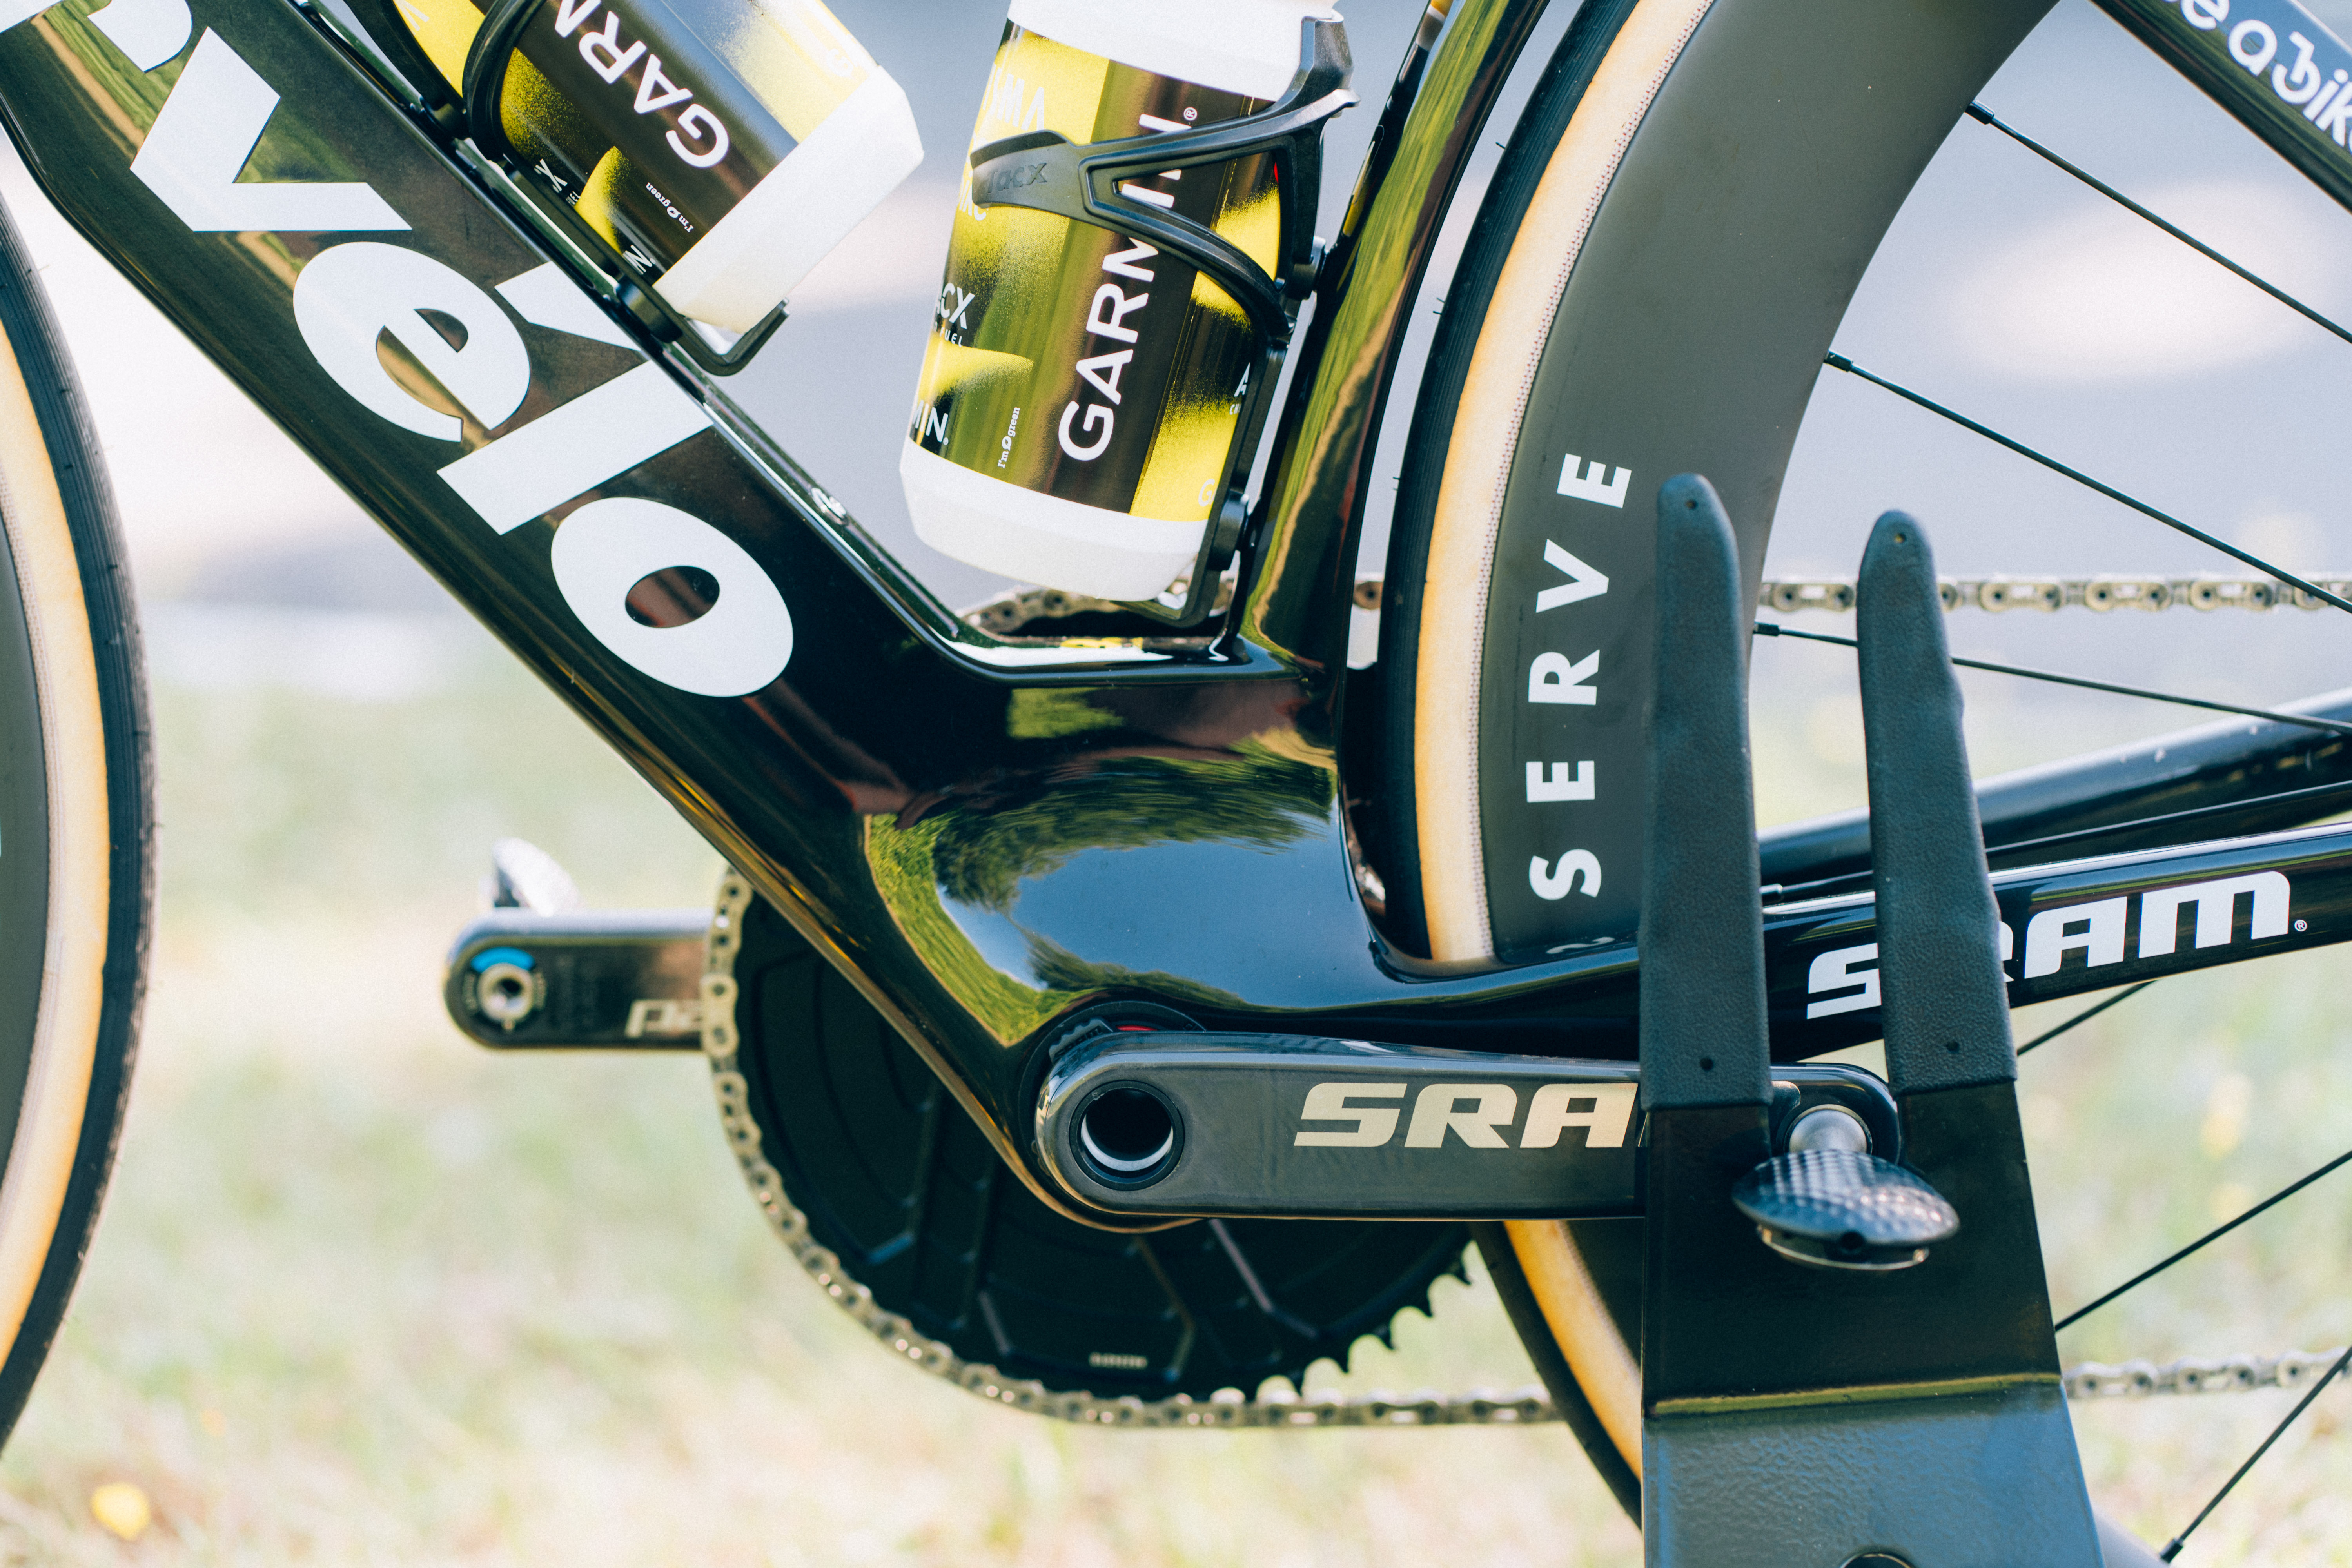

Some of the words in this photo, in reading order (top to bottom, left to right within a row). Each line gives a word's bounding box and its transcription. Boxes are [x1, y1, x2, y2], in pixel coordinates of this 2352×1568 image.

[2272, 31, 2352, 155] bik
[646, 182, 671, 207] green
[679, 215, 694, 232] I'm
[997, 451, 1009, 469] I'm
[1007, 407, 1020, 437] green
[1526, 453, 1632, 900] SERVE
[1294, 1082, 1648, 1149] SRA
